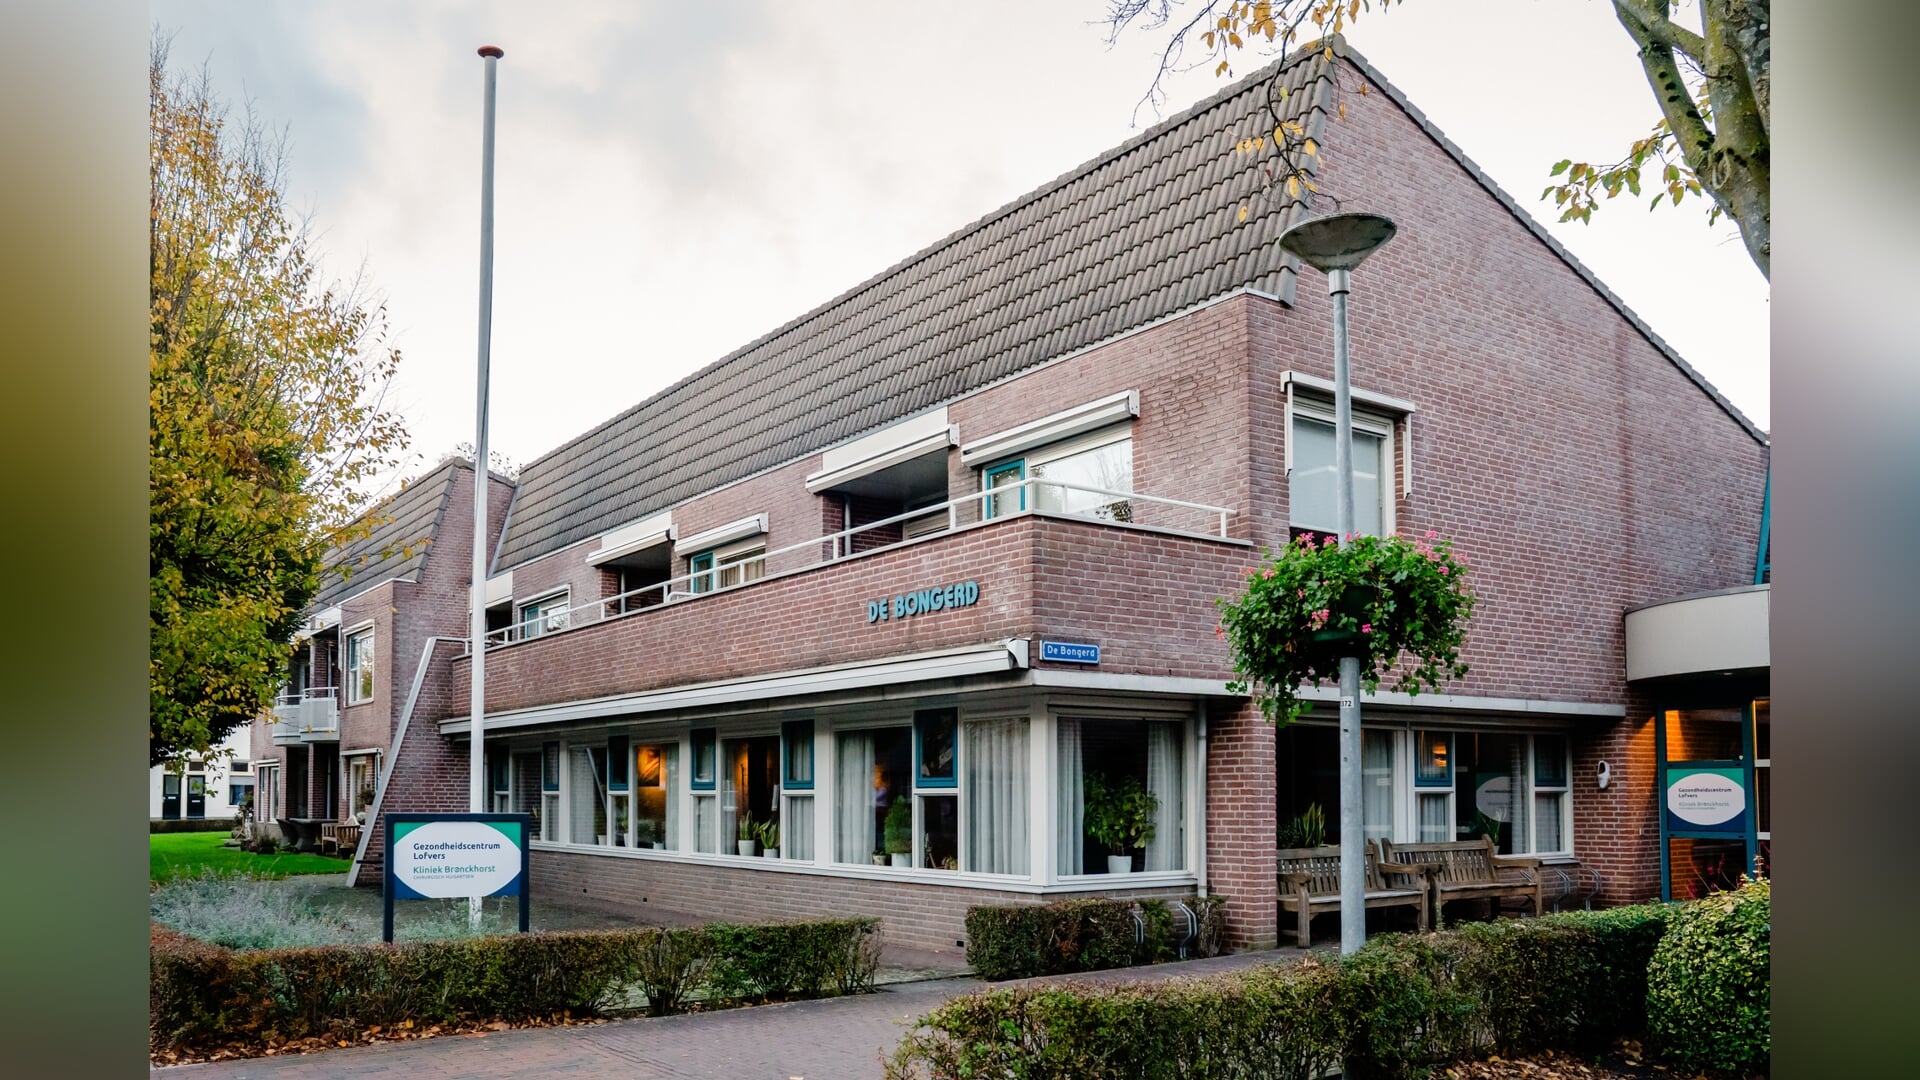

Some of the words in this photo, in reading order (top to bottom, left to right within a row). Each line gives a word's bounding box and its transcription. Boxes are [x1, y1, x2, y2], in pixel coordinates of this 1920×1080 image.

[868, 598, 889, 624] DE
[893, 580, 980, 619] BONGERD
[1047, 644, 1058, 655] De
[1060, 646, 1095, 659] Bongerd
[413, 842, 501, 851] Gezondheidscentrum
[413, 852, 446, 860] Lofvers
[413, 865, 443, 874] Kliniek
